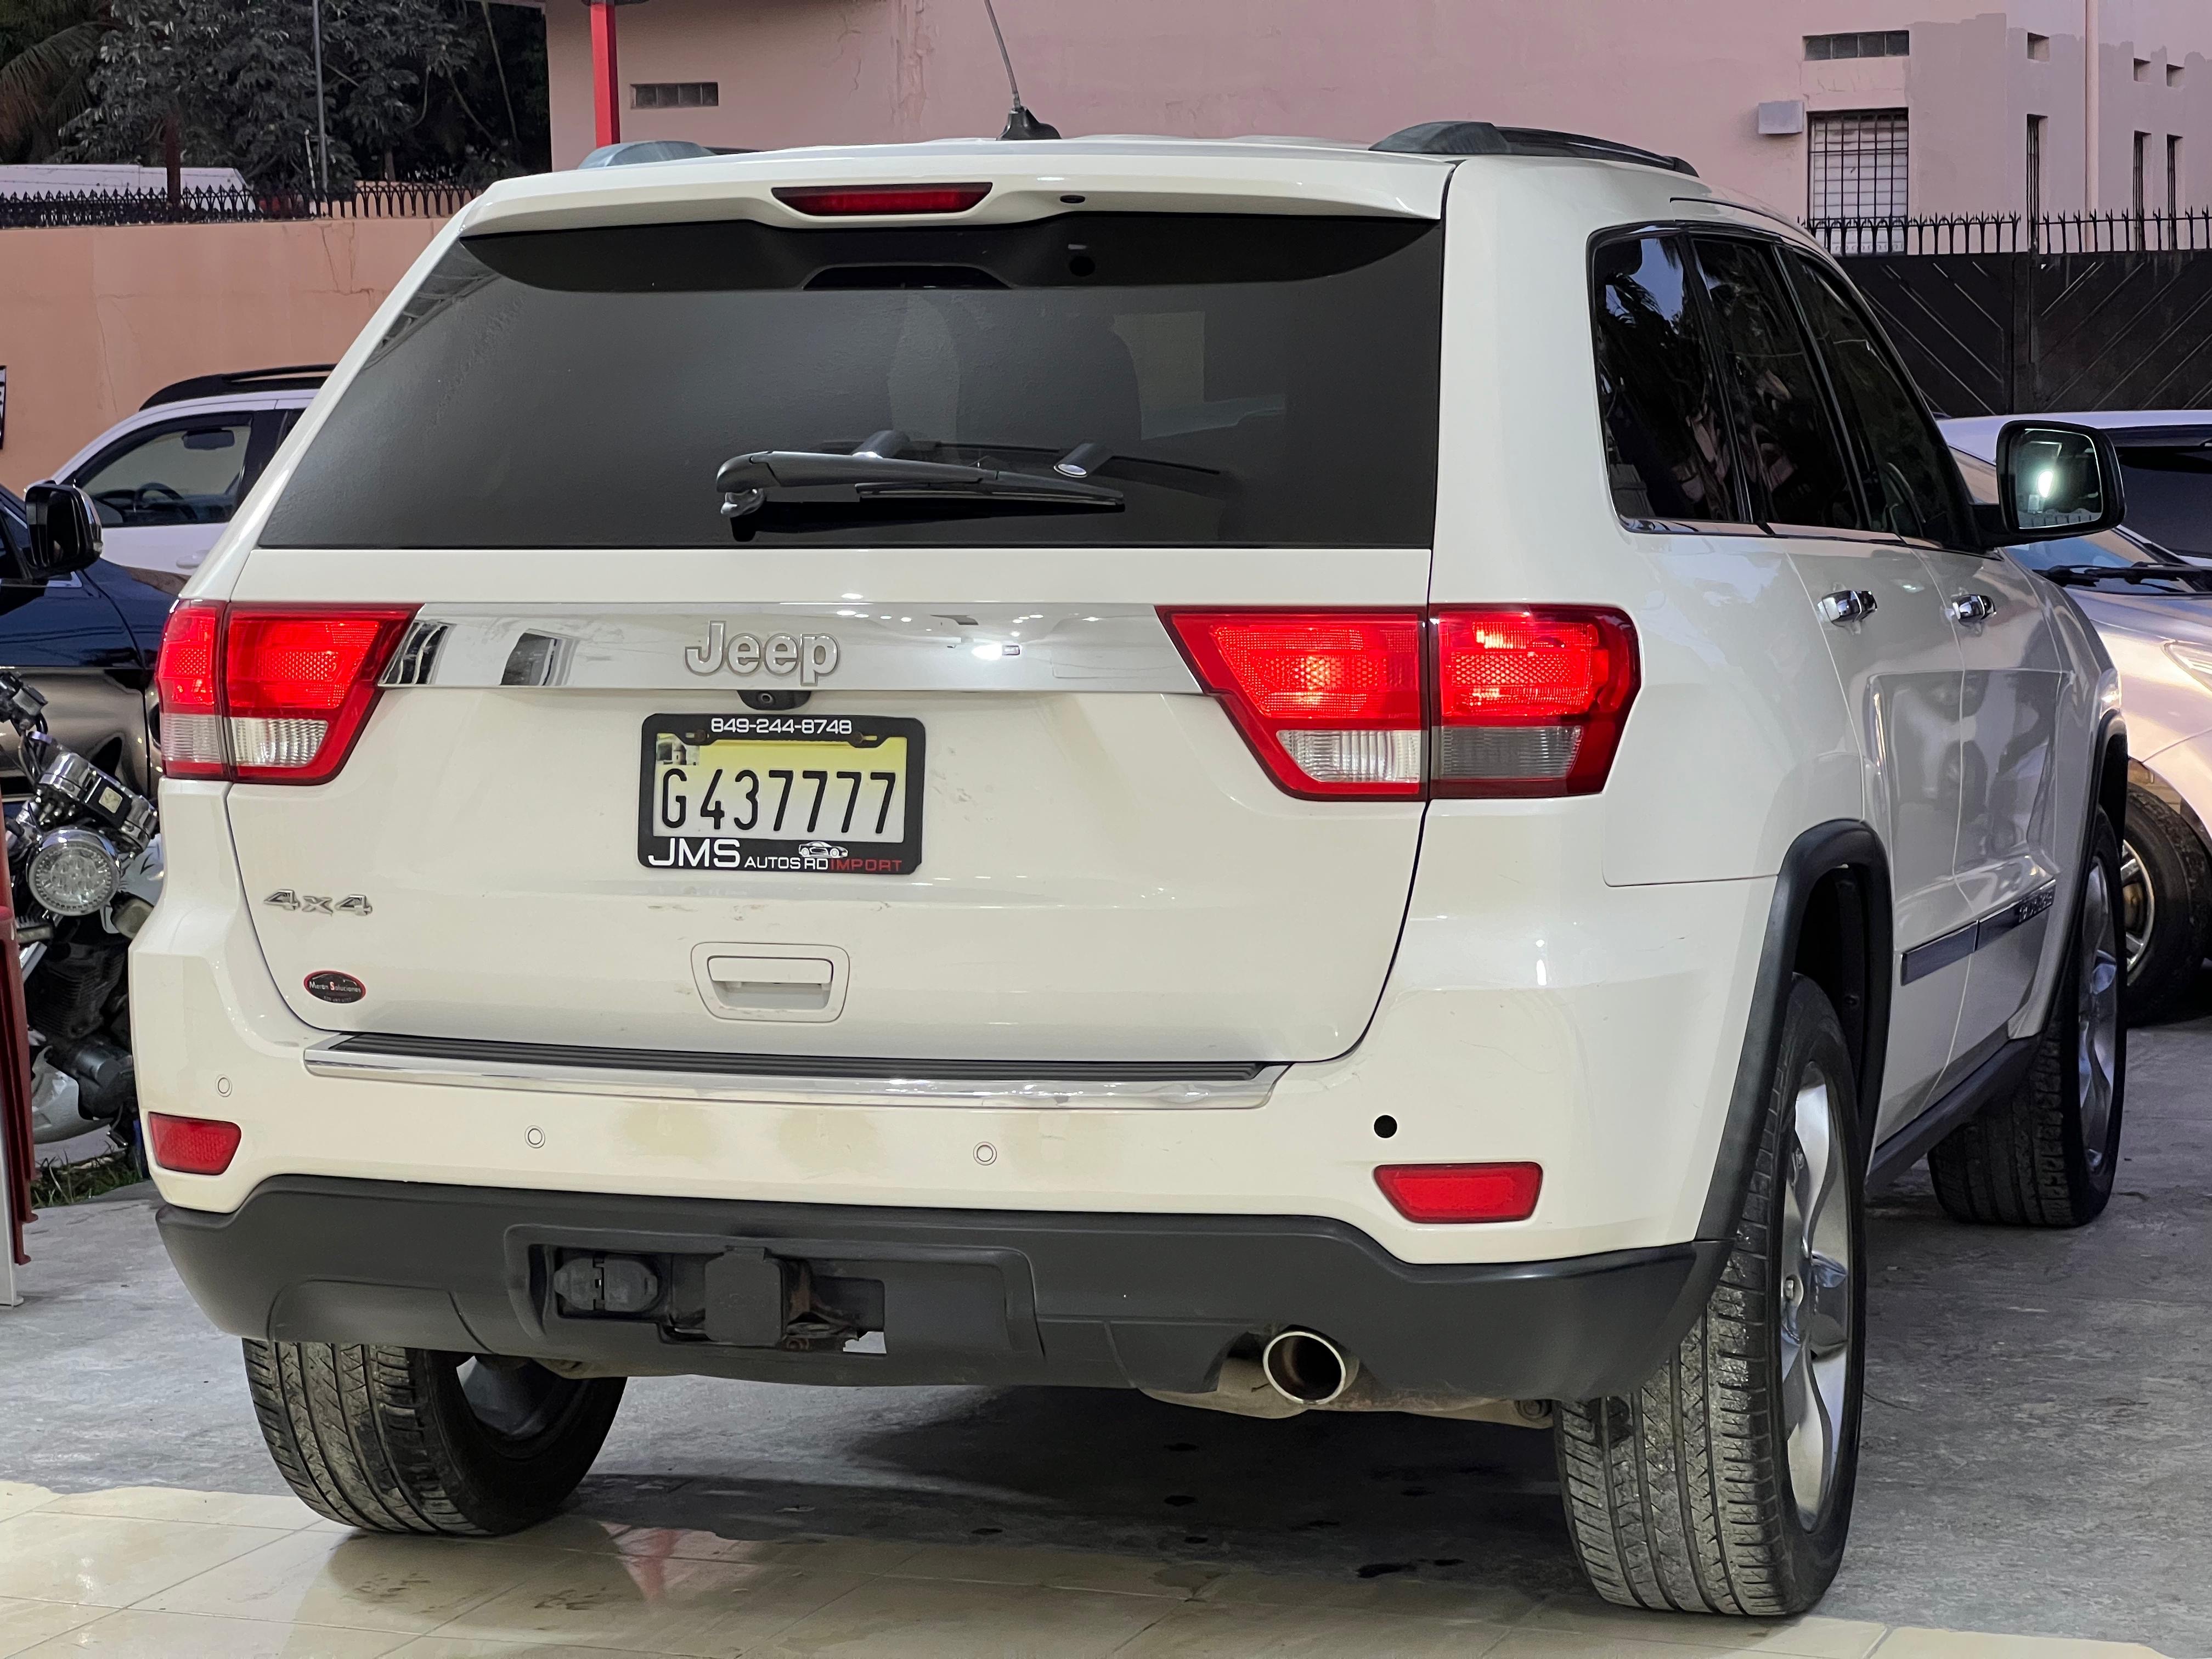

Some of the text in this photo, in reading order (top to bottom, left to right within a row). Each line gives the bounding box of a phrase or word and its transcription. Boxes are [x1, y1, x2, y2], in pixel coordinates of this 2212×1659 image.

[685, 620, 840, 686] Jeep
[710, 718, 853, 735] 849-244-8748
[662, 768, 896, 834] G437777
[648, 838, 902, 872] JMS AUTOS RD IMPORT
